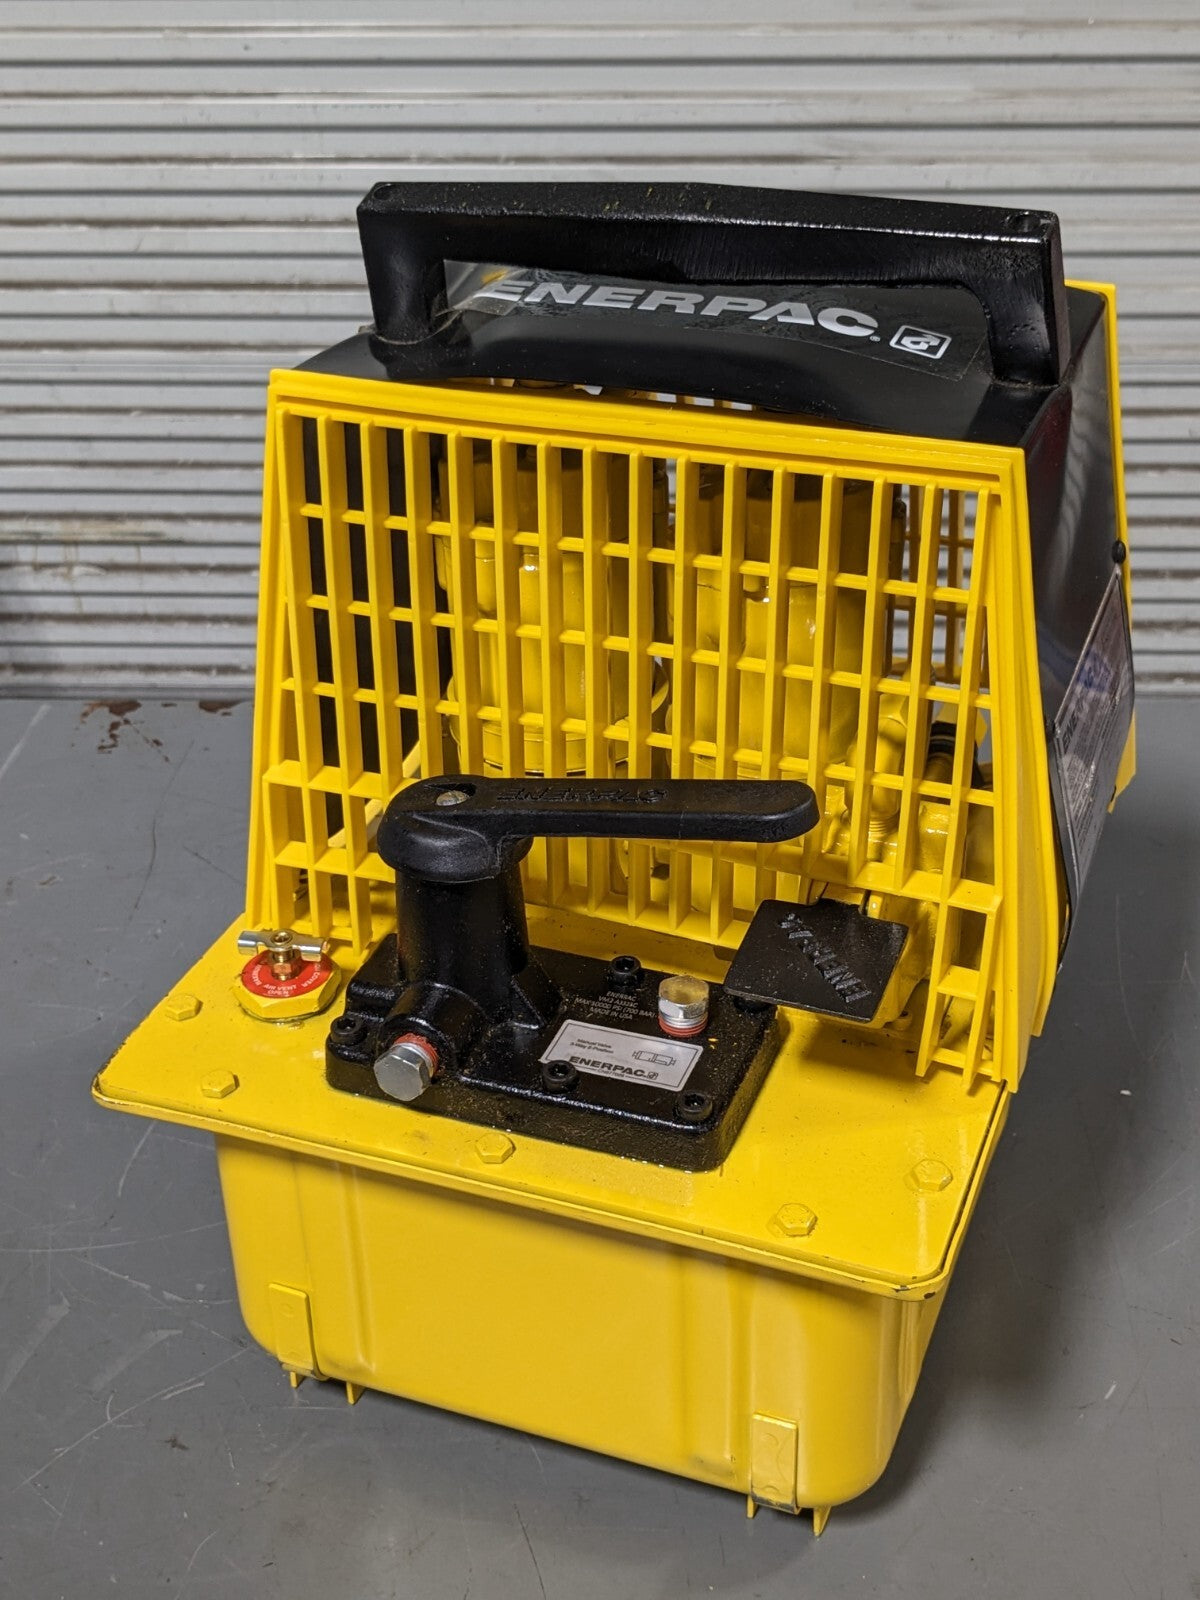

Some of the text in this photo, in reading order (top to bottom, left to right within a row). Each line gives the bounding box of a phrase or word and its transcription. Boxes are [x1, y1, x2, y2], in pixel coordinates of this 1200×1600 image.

[474, 280, 879, 337] ENERPAC
[606, 990, 637, 1002] ENERPAC
[574, 997, 591, 1006] MAX
[611, 1004, 622, 1012] PSI
[590, 1006, 611, 1016] MADE
[568, 1055, 646, 1078] ENERPAC
